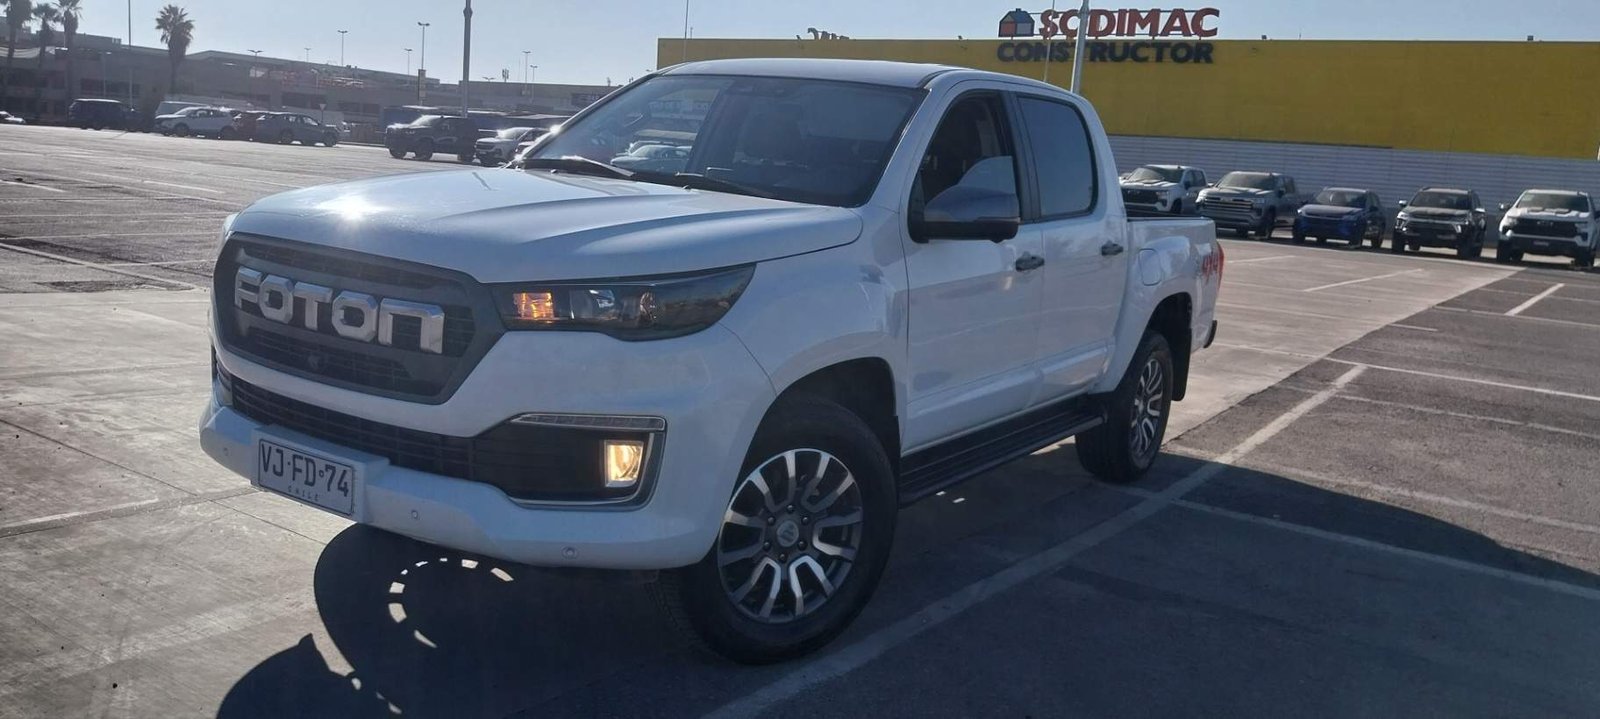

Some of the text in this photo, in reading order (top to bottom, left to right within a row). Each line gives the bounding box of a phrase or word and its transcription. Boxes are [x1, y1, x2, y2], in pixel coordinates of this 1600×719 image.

[1038, 8, 1220, 38] SODIMAC
[997, 41, 1215, 63] CONSRUCTOR
[234, 265, 446, 354] FOTON
